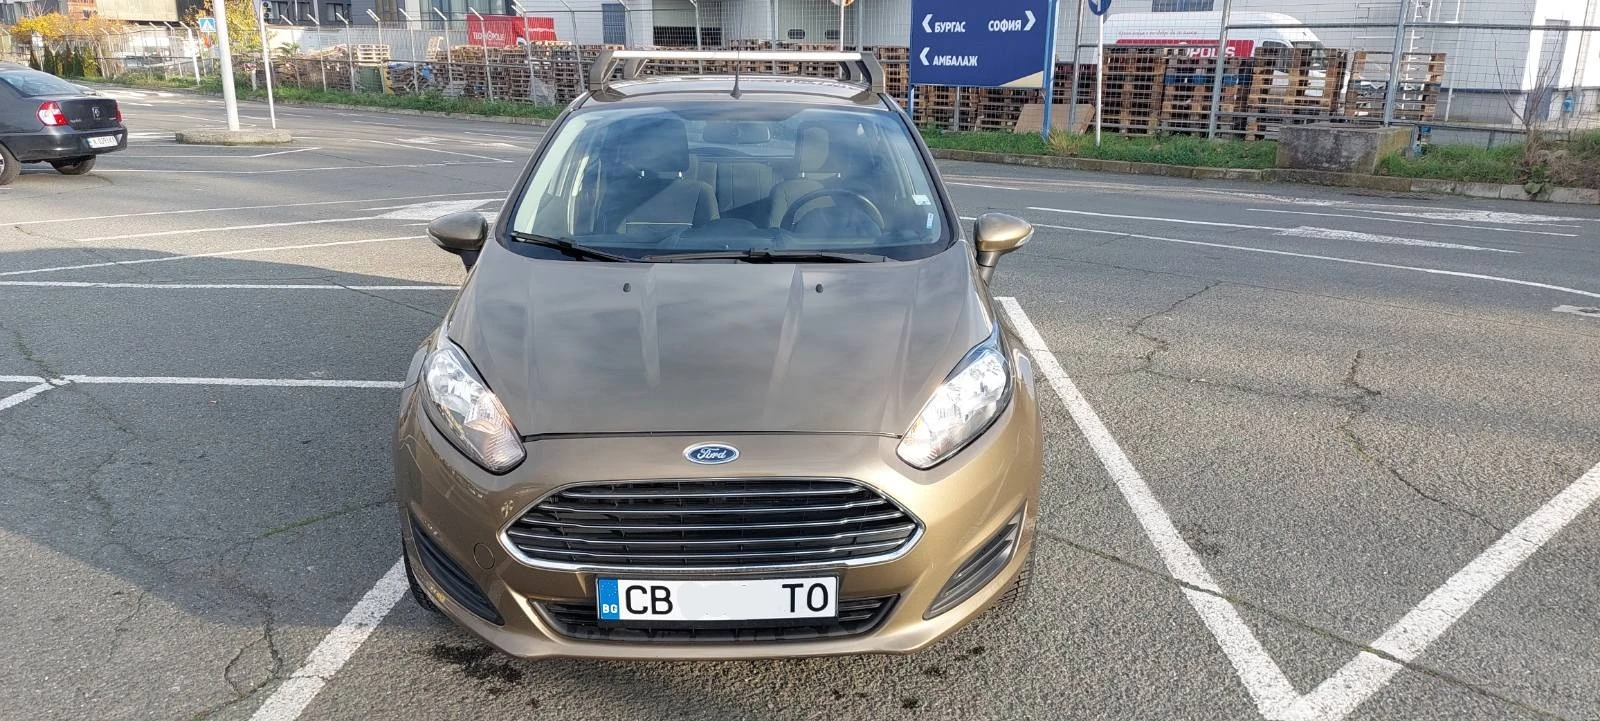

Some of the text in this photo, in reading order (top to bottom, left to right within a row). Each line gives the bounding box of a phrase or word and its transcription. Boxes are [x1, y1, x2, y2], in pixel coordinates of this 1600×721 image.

[934, 21, 966, 33] БУРГАС
[988, 19, 1022, 32] СОФИЯ
[933, 55, 978, 66] АМБАЛАЖ
[697, 448, 727, 459] Ford
[625, 582, 829, 615] CB TO
[603, 604, 618, 614] BG
